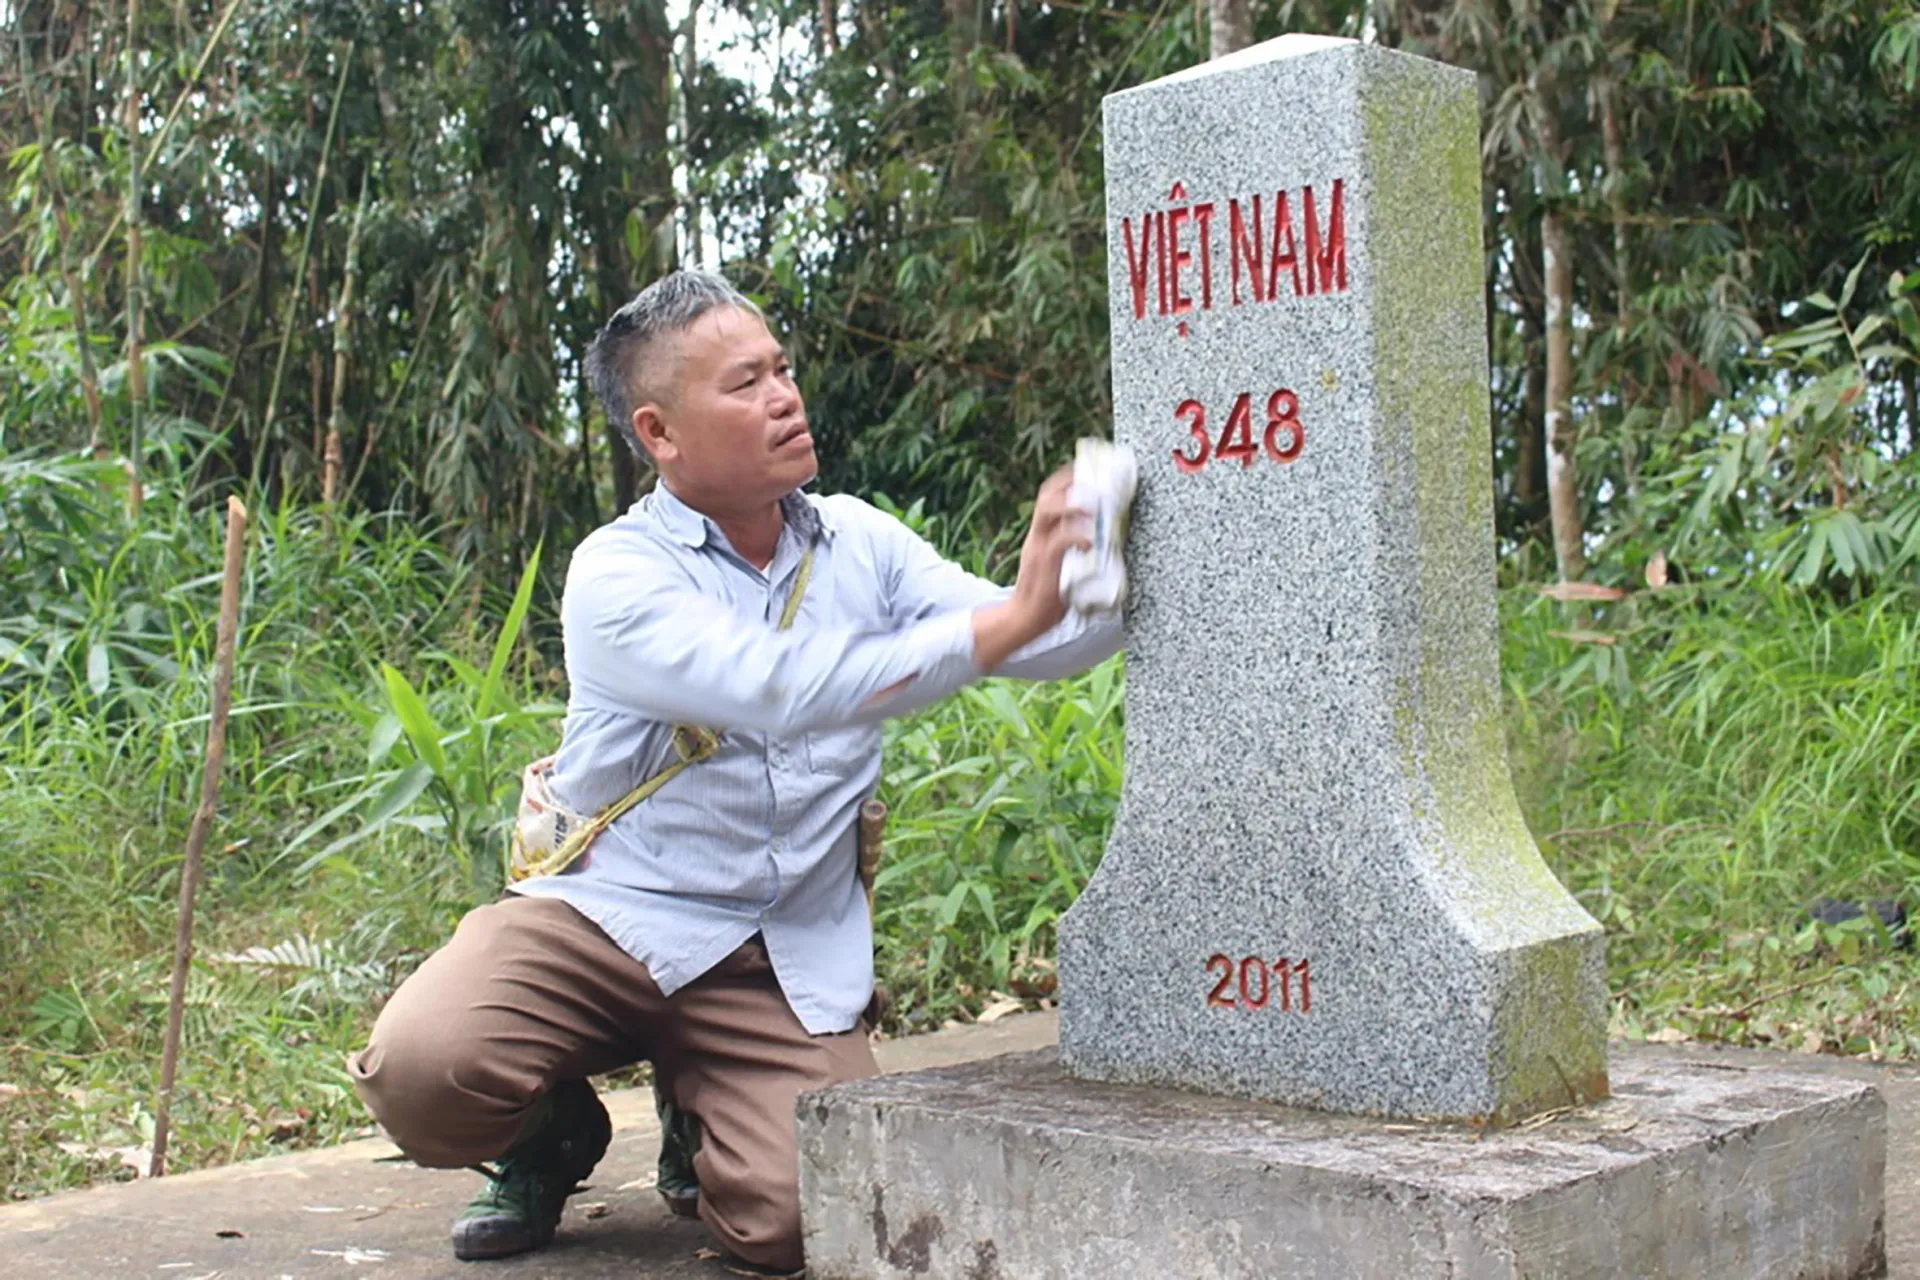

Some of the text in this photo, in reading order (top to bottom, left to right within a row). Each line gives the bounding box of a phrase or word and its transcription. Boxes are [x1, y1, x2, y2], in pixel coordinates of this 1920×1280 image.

[1121, 178, 1348, 338] VIỆT NAM
[1172, 388, 1305, 474] 348
[1206, 953, 1312, 1014] 2011
